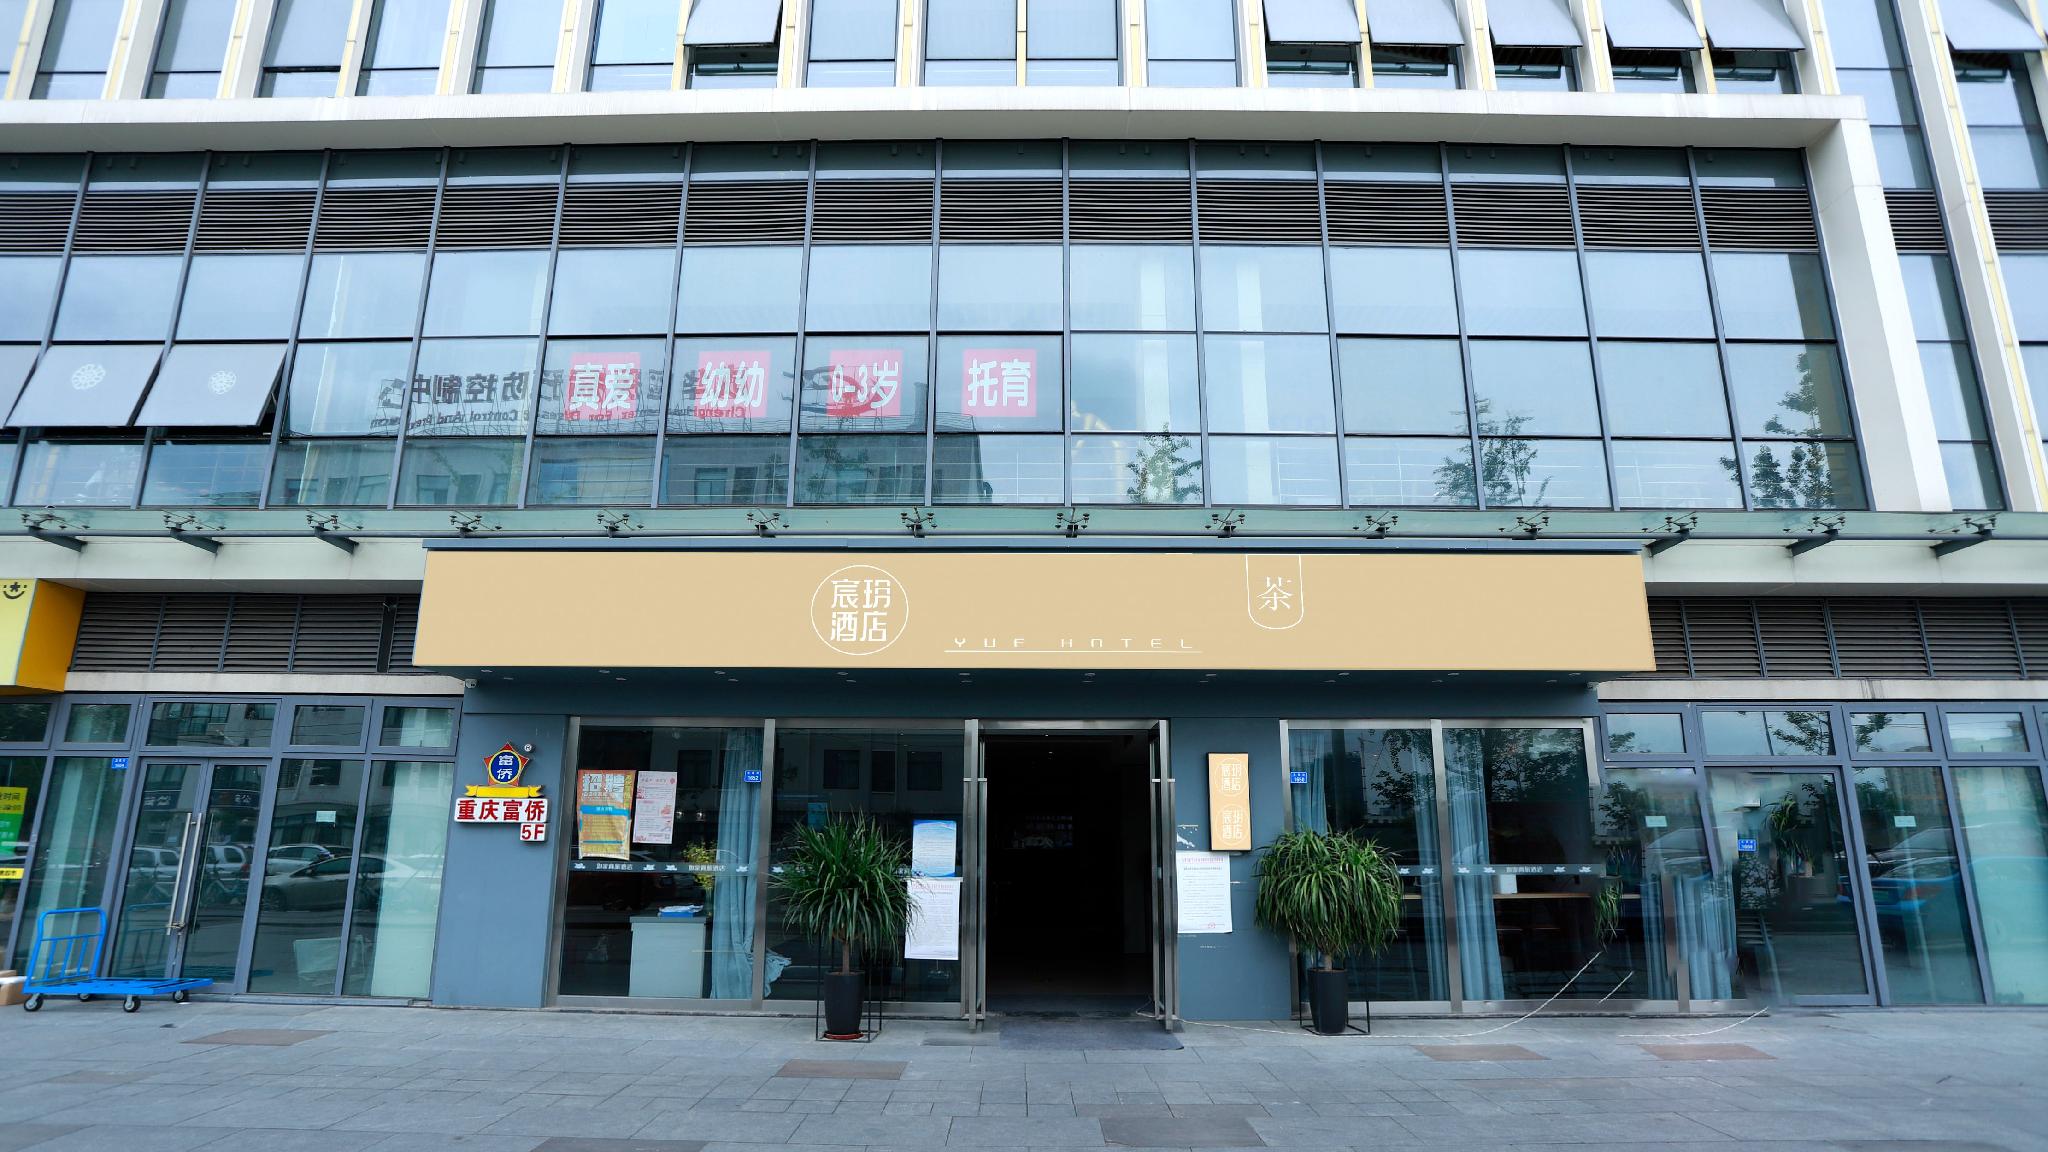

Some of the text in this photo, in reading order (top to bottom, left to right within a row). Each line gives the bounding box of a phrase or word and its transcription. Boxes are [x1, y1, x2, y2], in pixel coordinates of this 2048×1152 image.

[569, 362, 636, 411] 真爱
[700, 360, 765, 408] 幼幼
[831, 359, 899, 408] 0-3岁
[968, 358, 1031, 408] 托育
[1257, 576, 1293, 611] 茶
[830, 611, 887, 642] 酒店
[457, 799, 545, 821] 重庆富侨
[521, 825, 545, 840] 5F
